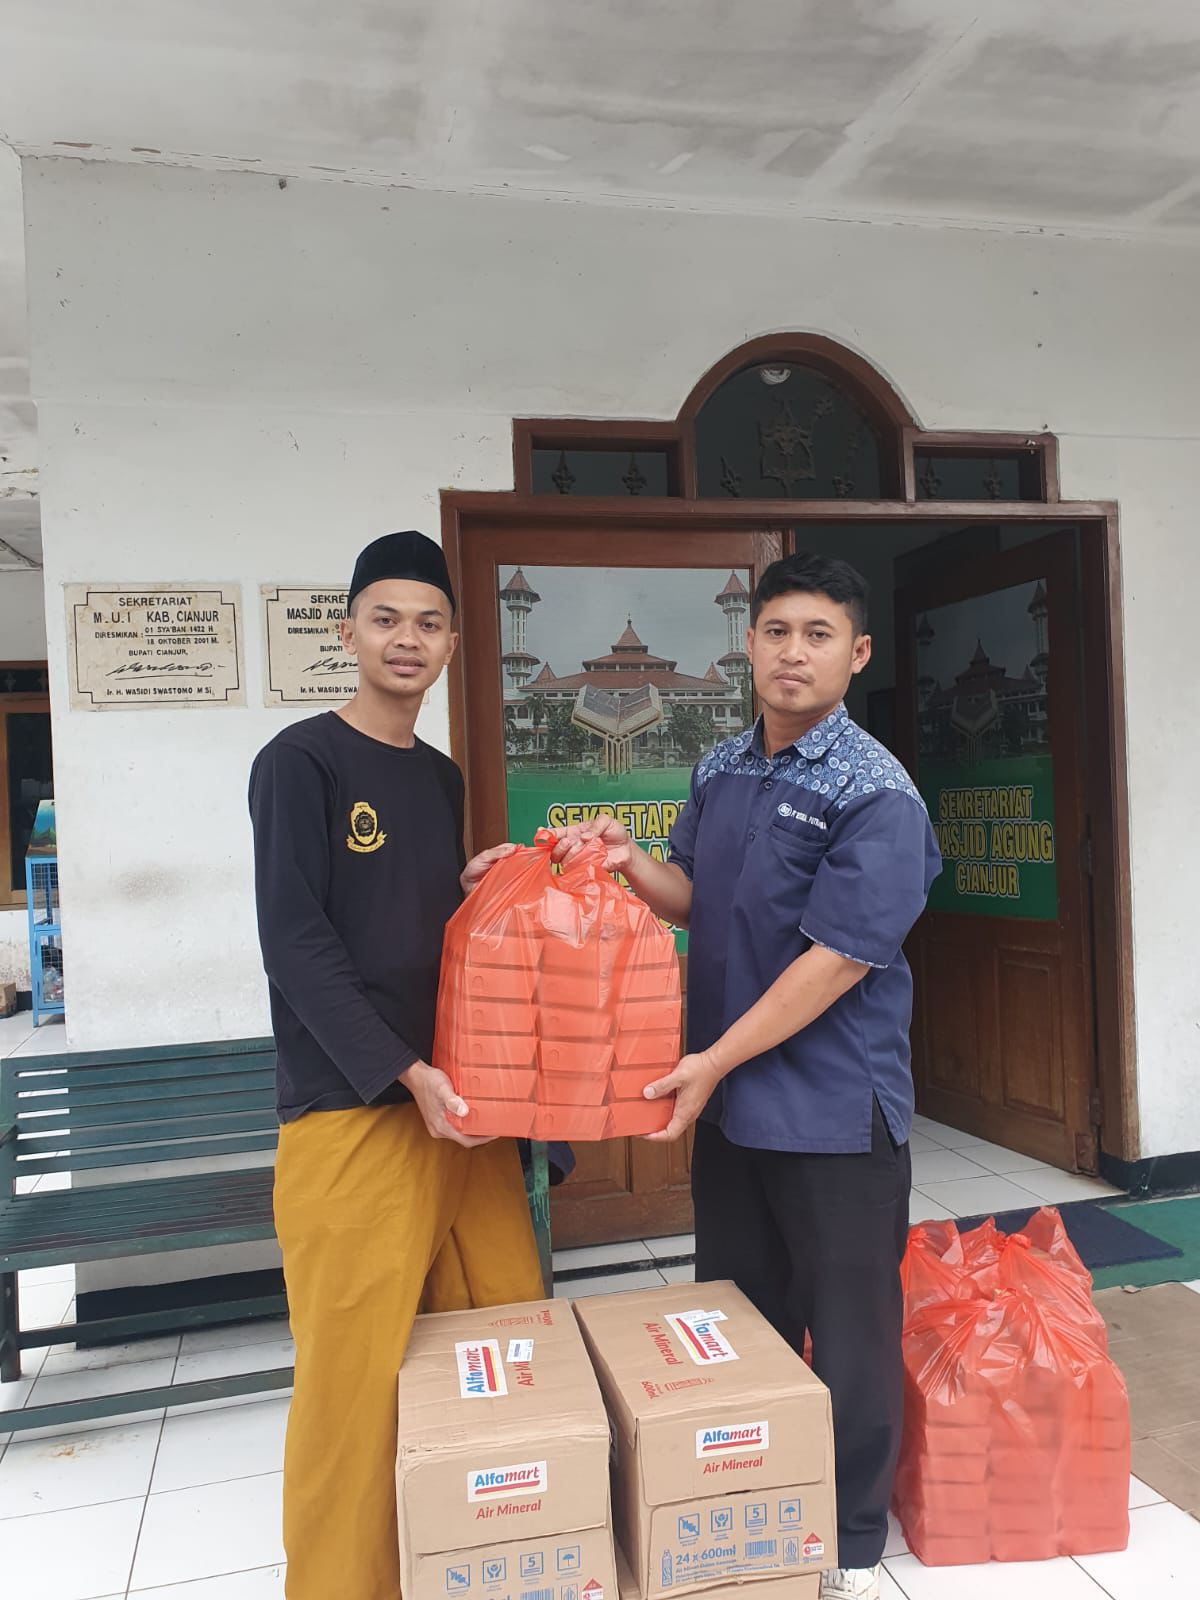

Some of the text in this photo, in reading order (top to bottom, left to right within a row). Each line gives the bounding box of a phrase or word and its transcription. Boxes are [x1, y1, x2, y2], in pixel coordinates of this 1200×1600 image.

[118, 597, 192, 607] SEKRETARIAT
[176, 610, 219, 622] CIANJUR
[287, 608, 322, 620] MASJID
[208, 625, 213, 633] H
[158, 637, 191, 645] OKTOBER
[194, 637, 209, 645] 2001
[319, 645, 343, 653] BUPATI
[128, 649, 153, 657] BUPATI
[940, 786, 1033, 820] SEKRETARIAT
[991, 822, 1054, 863] AGUNG
[956, 862, 1020, 897] CIANJUR
[643, 1321, 684, 1366] Air Mineral
[466, 1347, 486, 1393] Alfamart
[516, 1371, 535, 1387] Air
[703, 1425, 762, 1444] Alfamart
[703, 1456, 763, 1474] Air Mineral
[474, 1466, 540, 1487] Alfamart
[476, 1499, 542, 1520] Air Mineral
[675, 1552, 689, 1566] 24
[692, 1553, 699, 1563] x
[701, 1544, 736, 1561] 600ml
